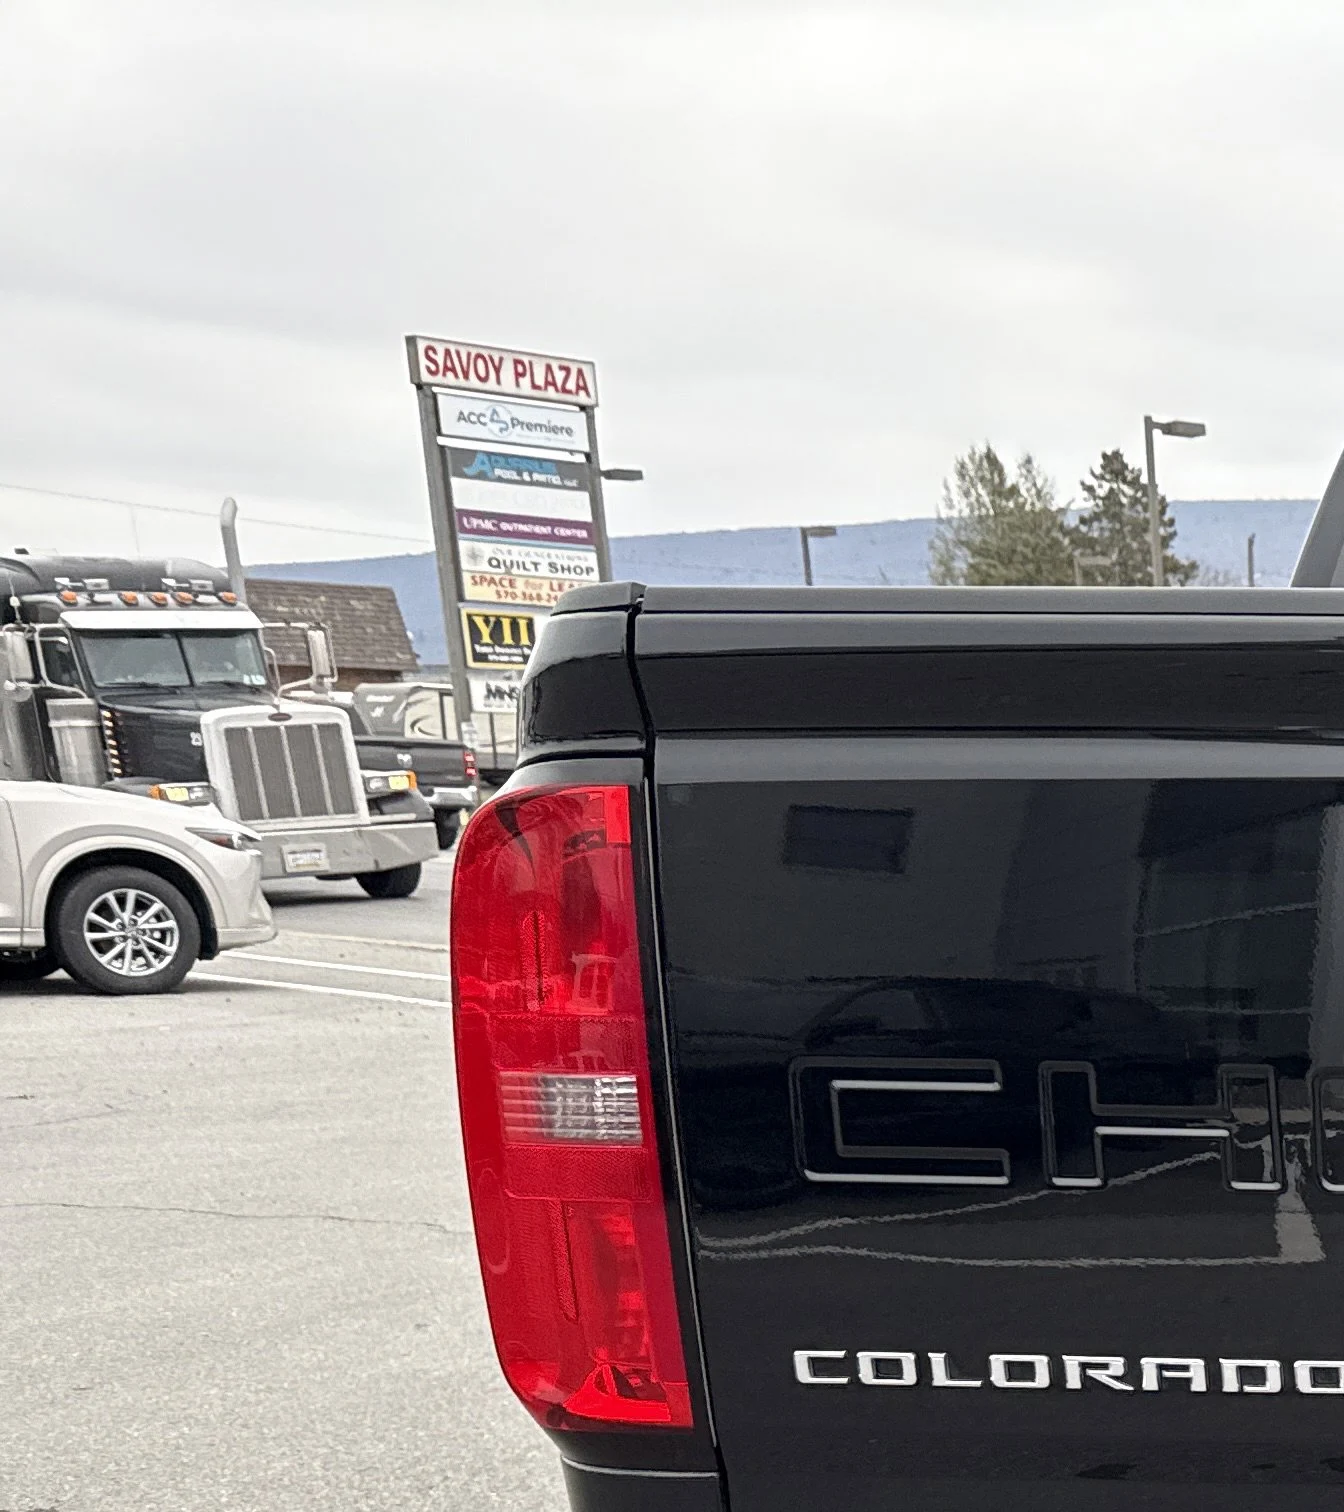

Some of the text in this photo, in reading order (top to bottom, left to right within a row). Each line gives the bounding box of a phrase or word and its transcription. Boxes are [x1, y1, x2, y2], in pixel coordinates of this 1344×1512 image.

[424, 345, 591, 398] SAVOY PLAZA
[457, 410, 574, 437] ACC Premiere
[463, 516, 498, 531] UPMC
[553, 527, 588, 539] CENTER
[487, 556, 595, 577] QUILT SHOP
[470, 575, 517, 589] SPACE
